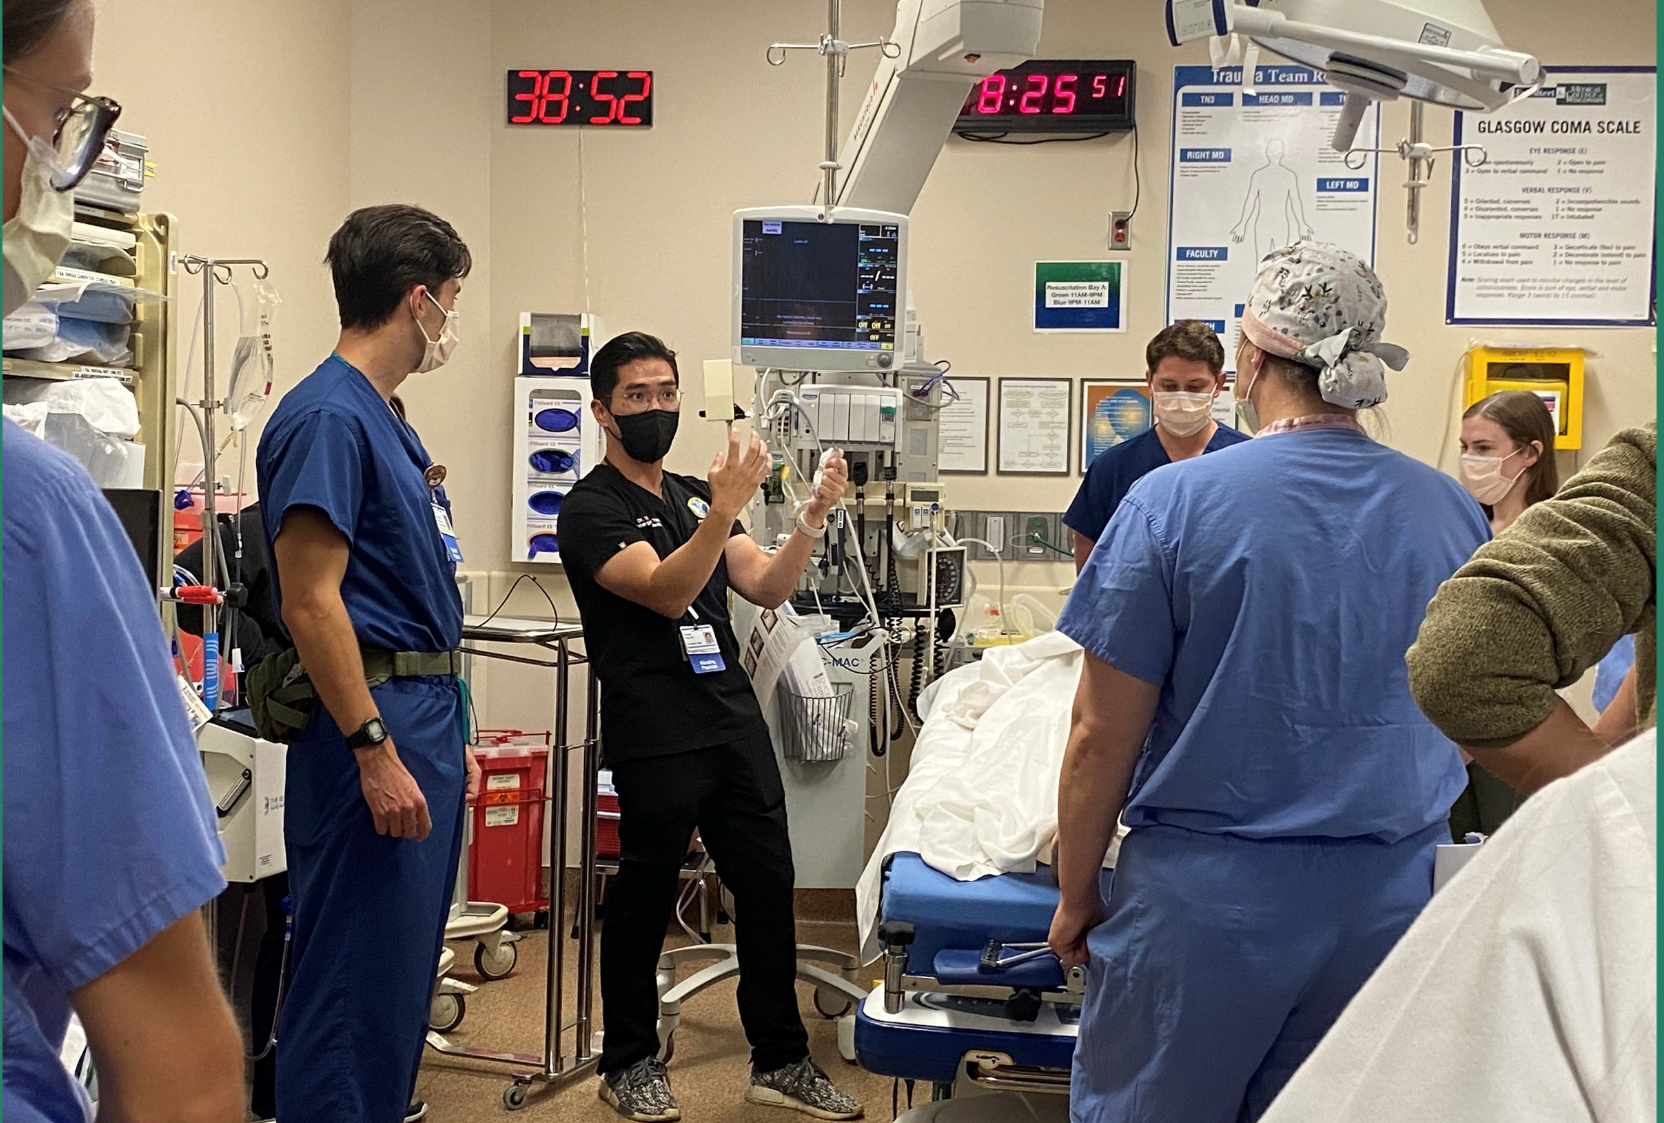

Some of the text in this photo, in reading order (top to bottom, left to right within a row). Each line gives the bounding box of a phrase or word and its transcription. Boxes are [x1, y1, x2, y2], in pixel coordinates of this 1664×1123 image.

[1211, 69, 1263, 83] Traua
[1267, 69, 1308, 82] Team
[511, 71, 651, 124] 38:52
[977, 74, 1078, 113] 8:25
[1258, 95, 1294, 104] HEAD MD
[1477, 120, 1641, 134] GLASGOW COMA SCALE
[1186, 151, 1225, 160] RIGHT MD
[1326, 180, 1360, 189] LEFT MD
[1185, 249, 1218, 258] FACULTY
